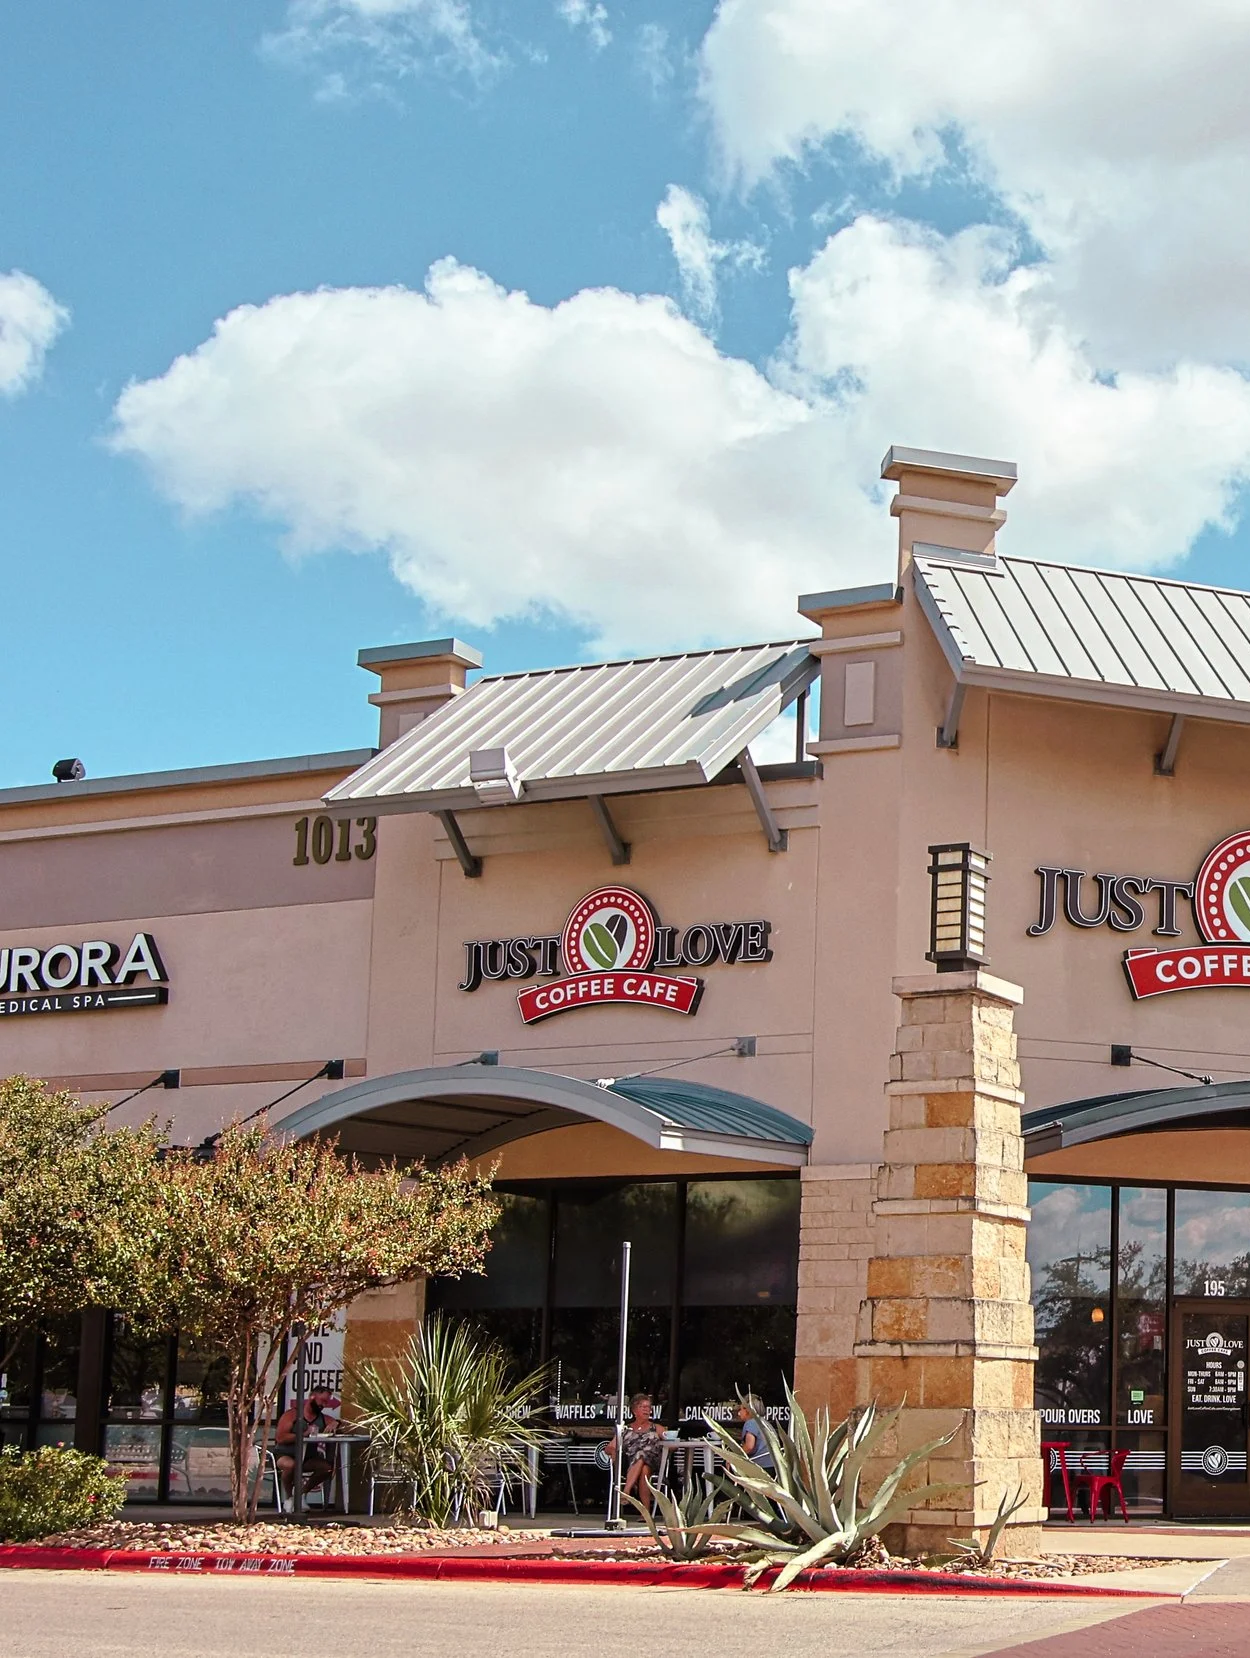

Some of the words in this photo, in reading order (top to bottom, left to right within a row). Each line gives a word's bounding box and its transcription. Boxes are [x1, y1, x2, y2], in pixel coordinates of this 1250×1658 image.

[293, 816, 376, 865] 1013
[1027, 866, 1195, 937] JUST
[458, 934, 561, 991] JUST
[654, 920, 772, 968] LOVE
[73, 995, 105, 1008] SPA
[535, 978, 614, 1010] COFFEE
[622, 978, 679, 1003] CAFE
[1203, 1280, 1225, 1297] 195
[1186, 1339, 1206, 1349] JUST
[1223, 1340, 1244, 1349] LOVE
[1222, 1395, 1237, 1404] LOVE
[556, 1404, 596, 1420] WAFFLES
[685, 1406, 733, 1421] CALZONES
[1039, 1409, 1066, 1424] POUR
[1068, 1409, 1100, 1424] OVERS
[1127, 1409, 1154, 1424] LOVE
[149, 1556, 173, 1569] FIRE
[176, 1557, 204, 1570] ZONE
[214, 1557, 236, 1570] TOW
[239, 1558, 265, 1571] AWAY
[268, 1558, 298, 1573] ZONE
